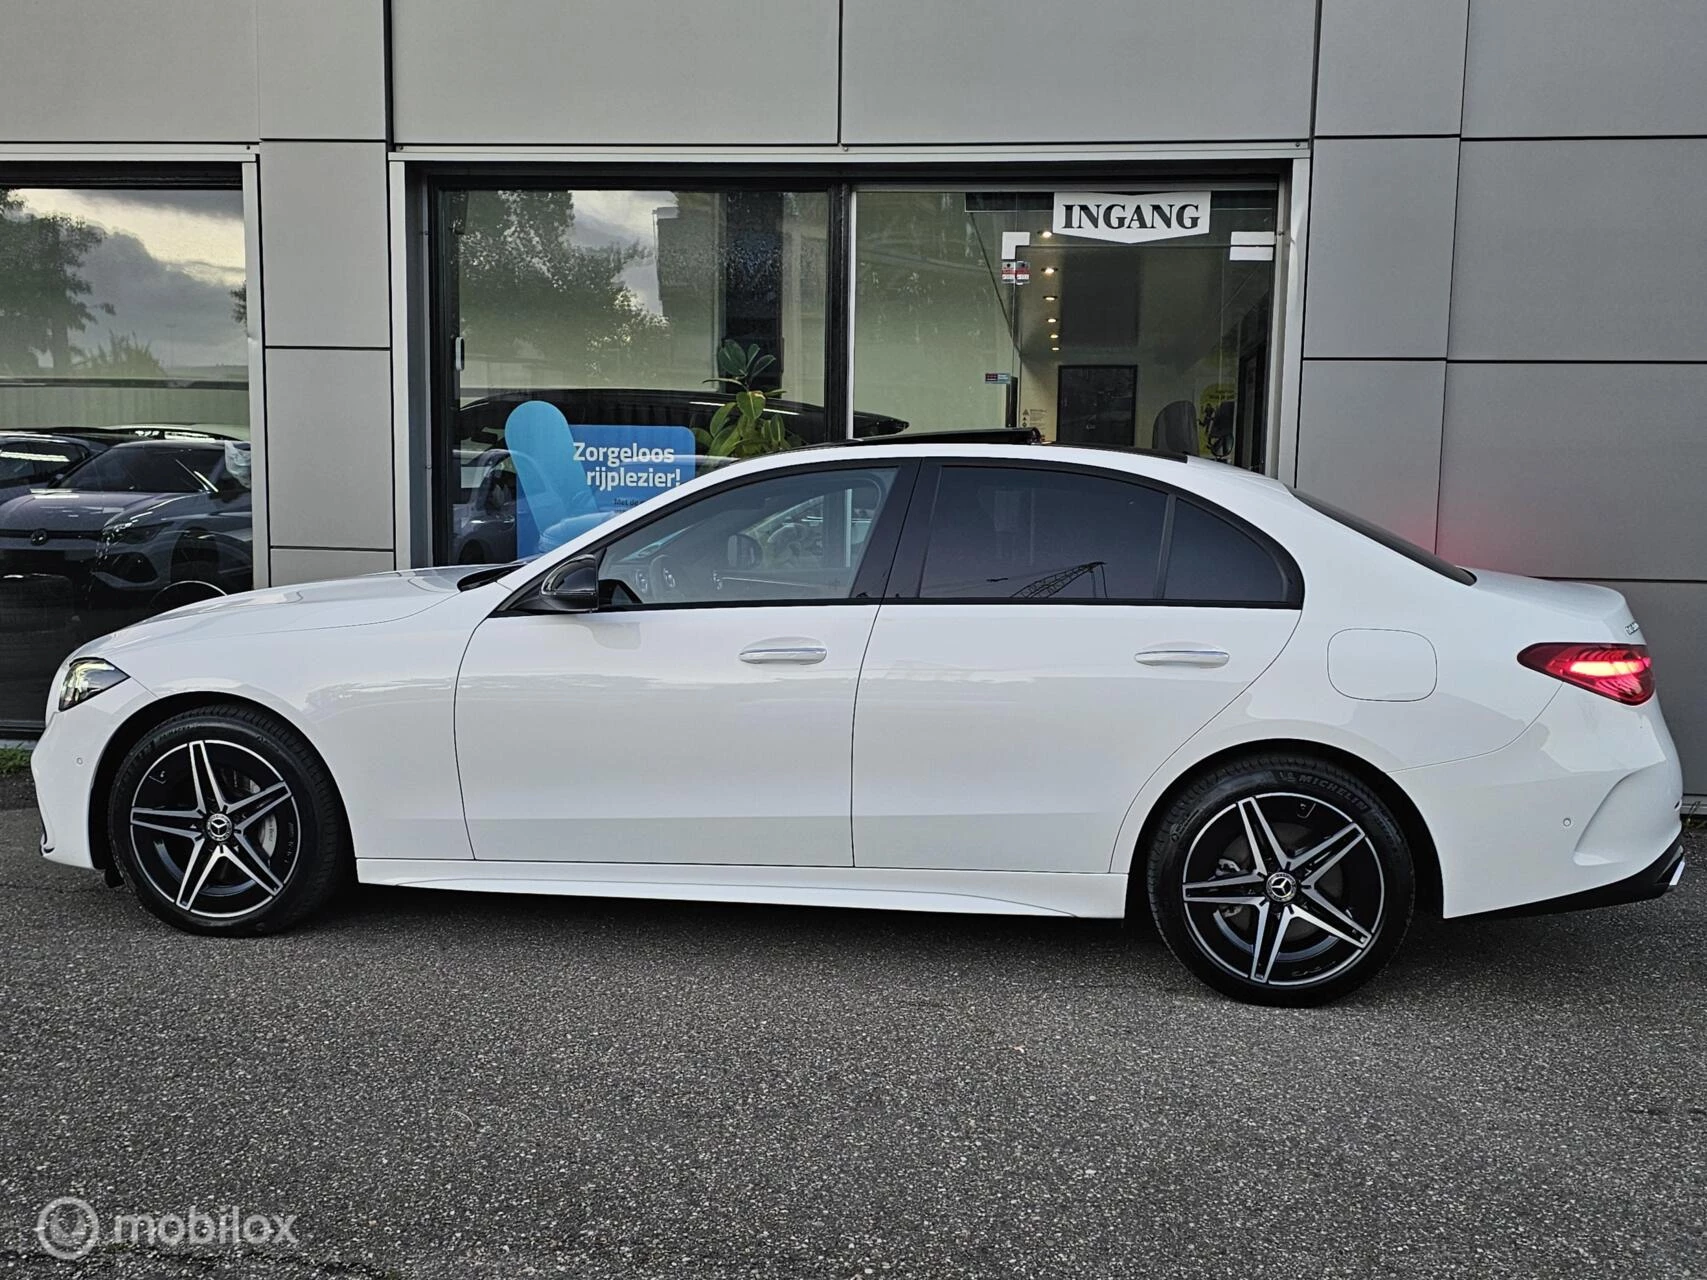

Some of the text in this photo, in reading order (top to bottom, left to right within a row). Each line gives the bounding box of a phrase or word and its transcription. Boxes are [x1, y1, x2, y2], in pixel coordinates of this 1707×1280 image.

[1062, 203, 1200, 229] INGANG
[573, 443, 675, 467] Zorgeloos
[587, 467, 681, 491] rijplezier!
[1299, 774, 1368, 811] MICHELIN
